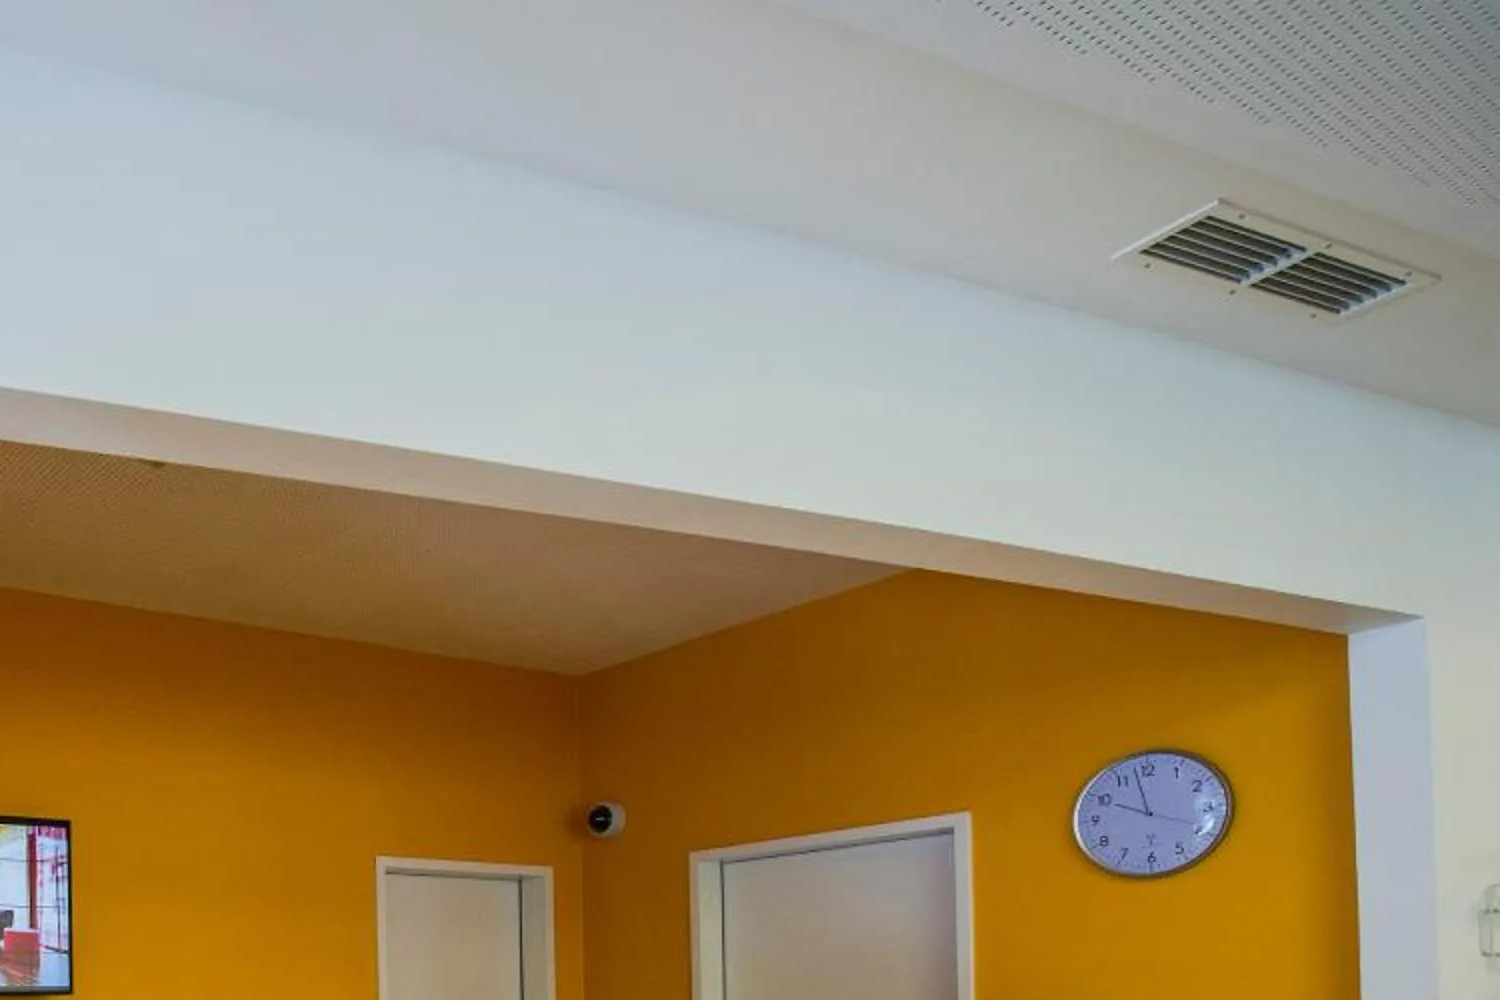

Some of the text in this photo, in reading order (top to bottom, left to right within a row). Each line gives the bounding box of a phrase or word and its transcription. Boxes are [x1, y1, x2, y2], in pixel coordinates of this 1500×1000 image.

[1141, 763, 1156, 777] 12
[1174, 767, 1180, 779] 1
[1117, 775, 1129, 788] 11
[1192, 780, 1203, 793] 2
[1098, 793, 1112, 806] 10
[1091, 815, 1100, 826] 9
[1100, 835, 1109, 847] 8
[1121, 848, 1129, 860] 7
[1175, 842, 1185, 855] 5
[1147, 852, 1156, 863] 6
